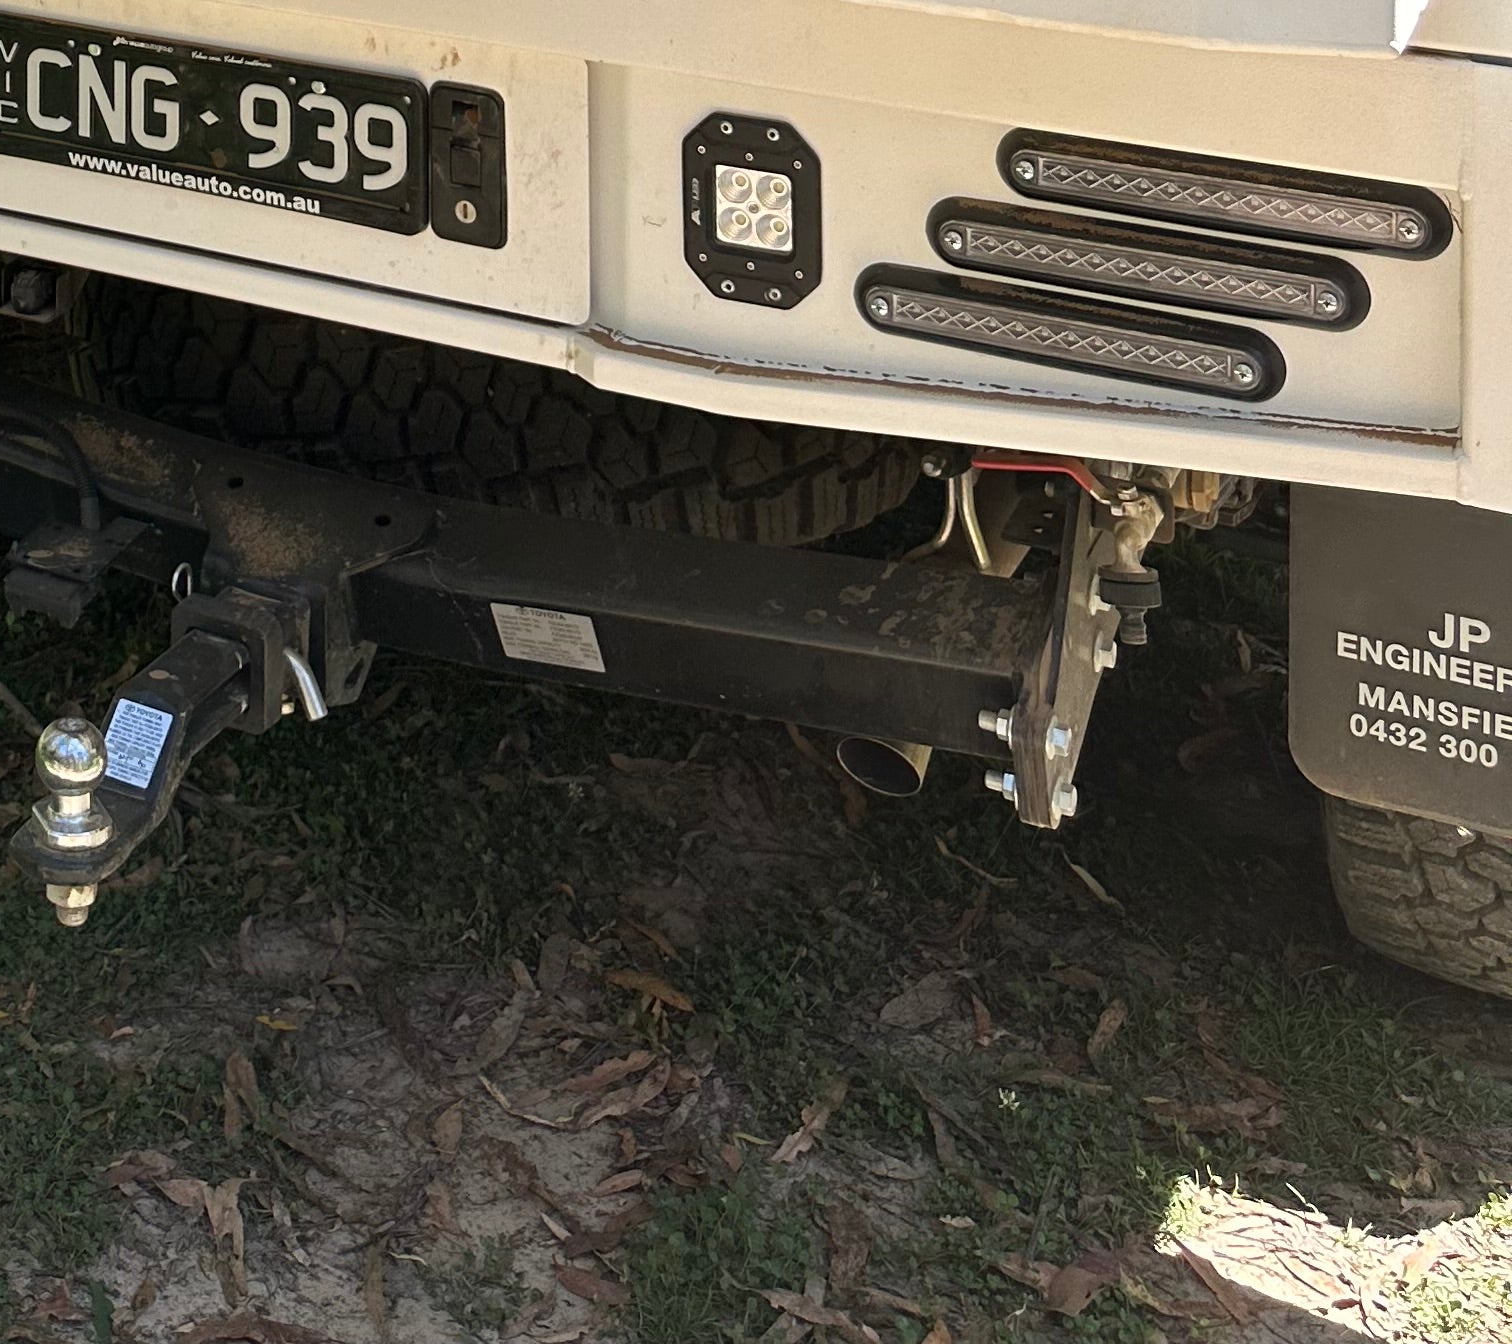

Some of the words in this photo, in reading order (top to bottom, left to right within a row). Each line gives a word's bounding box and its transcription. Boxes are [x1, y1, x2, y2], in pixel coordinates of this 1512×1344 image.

[26, 47, 180, 152] CNG
[239, 82, 408, 191] 939
[67, 151, 321, 214] www.valueauto.com.au
[1428, 612, 1491, 653] JP
[136, 706, 163, 722] TOYOTA
[1358, 681, 1512, 741] MANSFIE
[1349, 713, 1428, 753] 0432
[1438, 734, 1499, 768] 300
